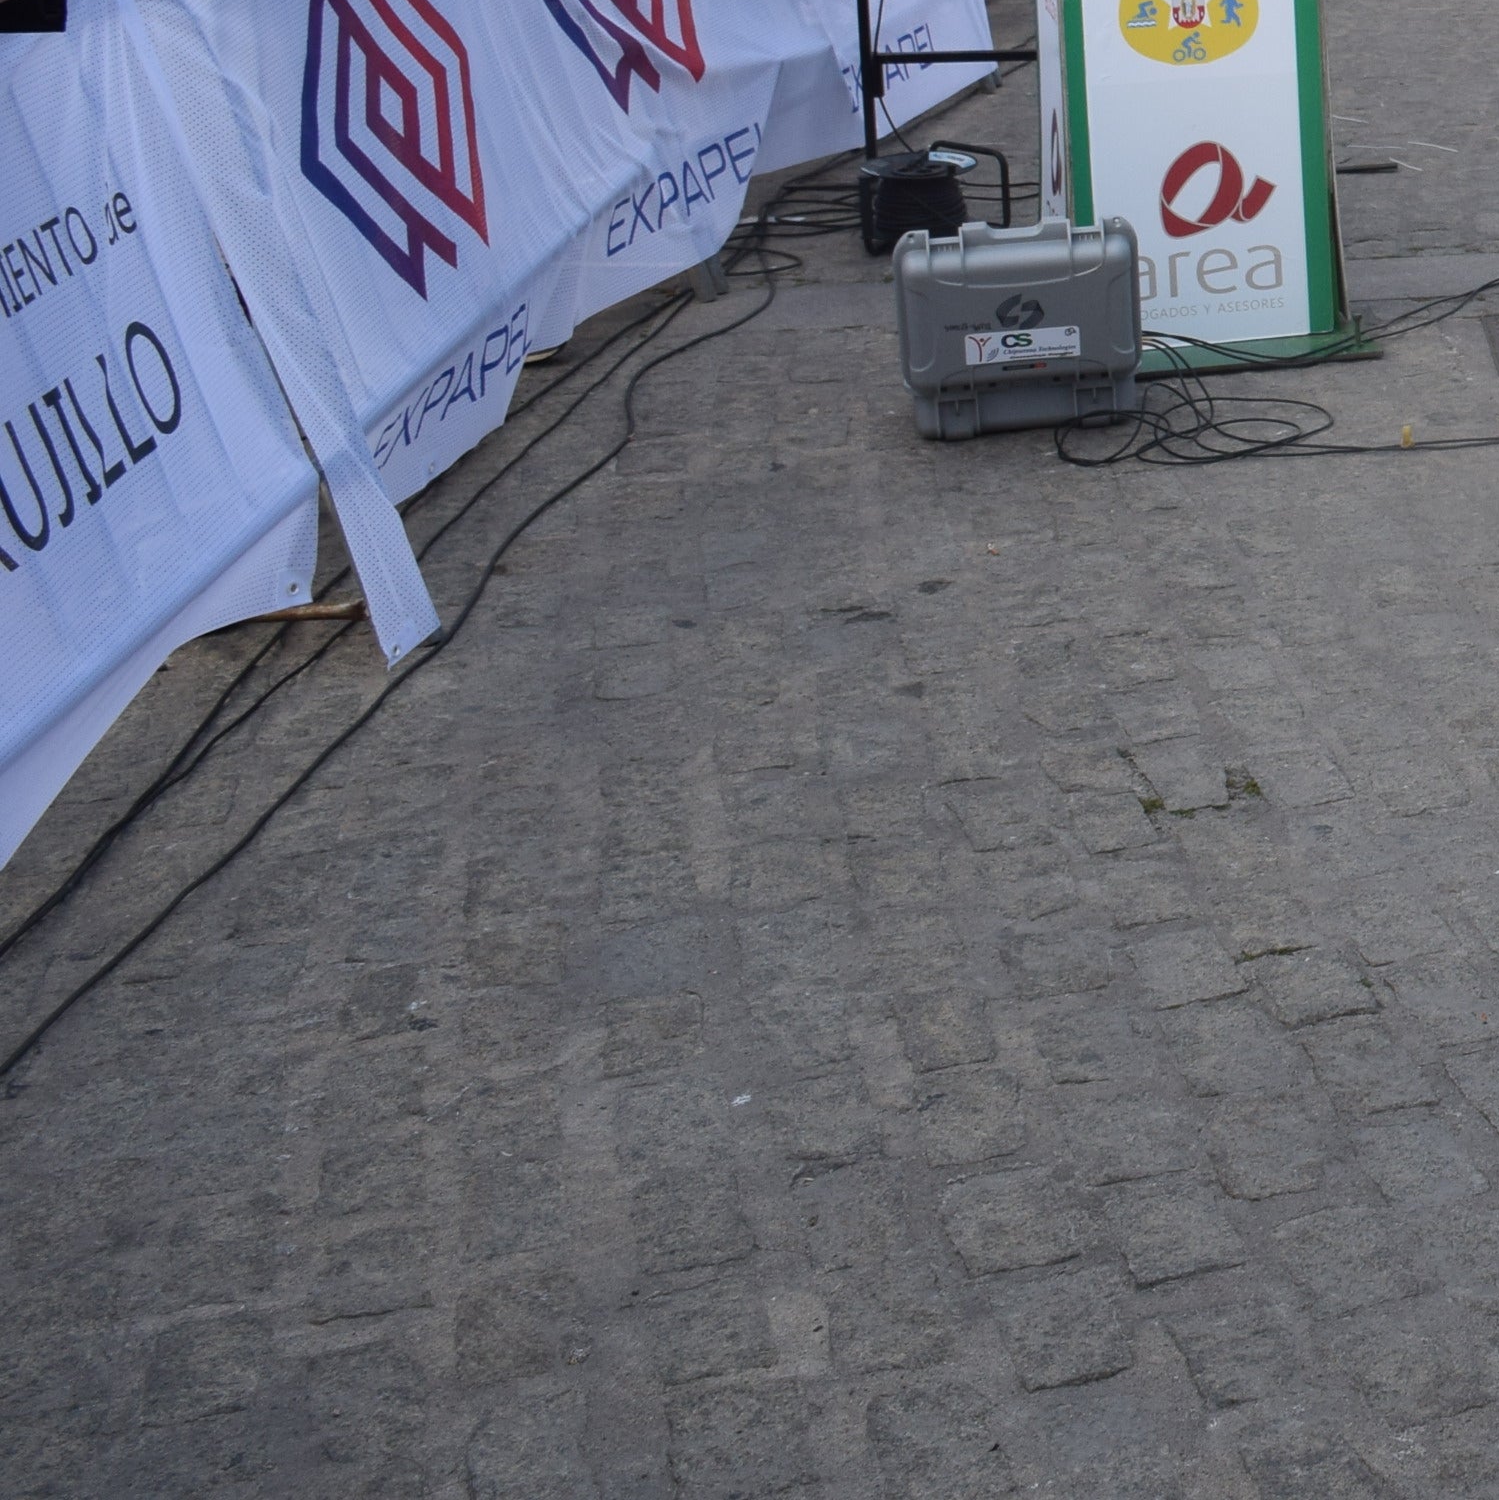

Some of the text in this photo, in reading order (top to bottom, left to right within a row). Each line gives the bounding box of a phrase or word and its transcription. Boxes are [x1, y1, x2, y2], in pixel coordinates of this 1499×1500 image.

[1140, 297, 1285, 321] OGADOS Y ASESORES
[1001, 332, 1033, 348] CS
